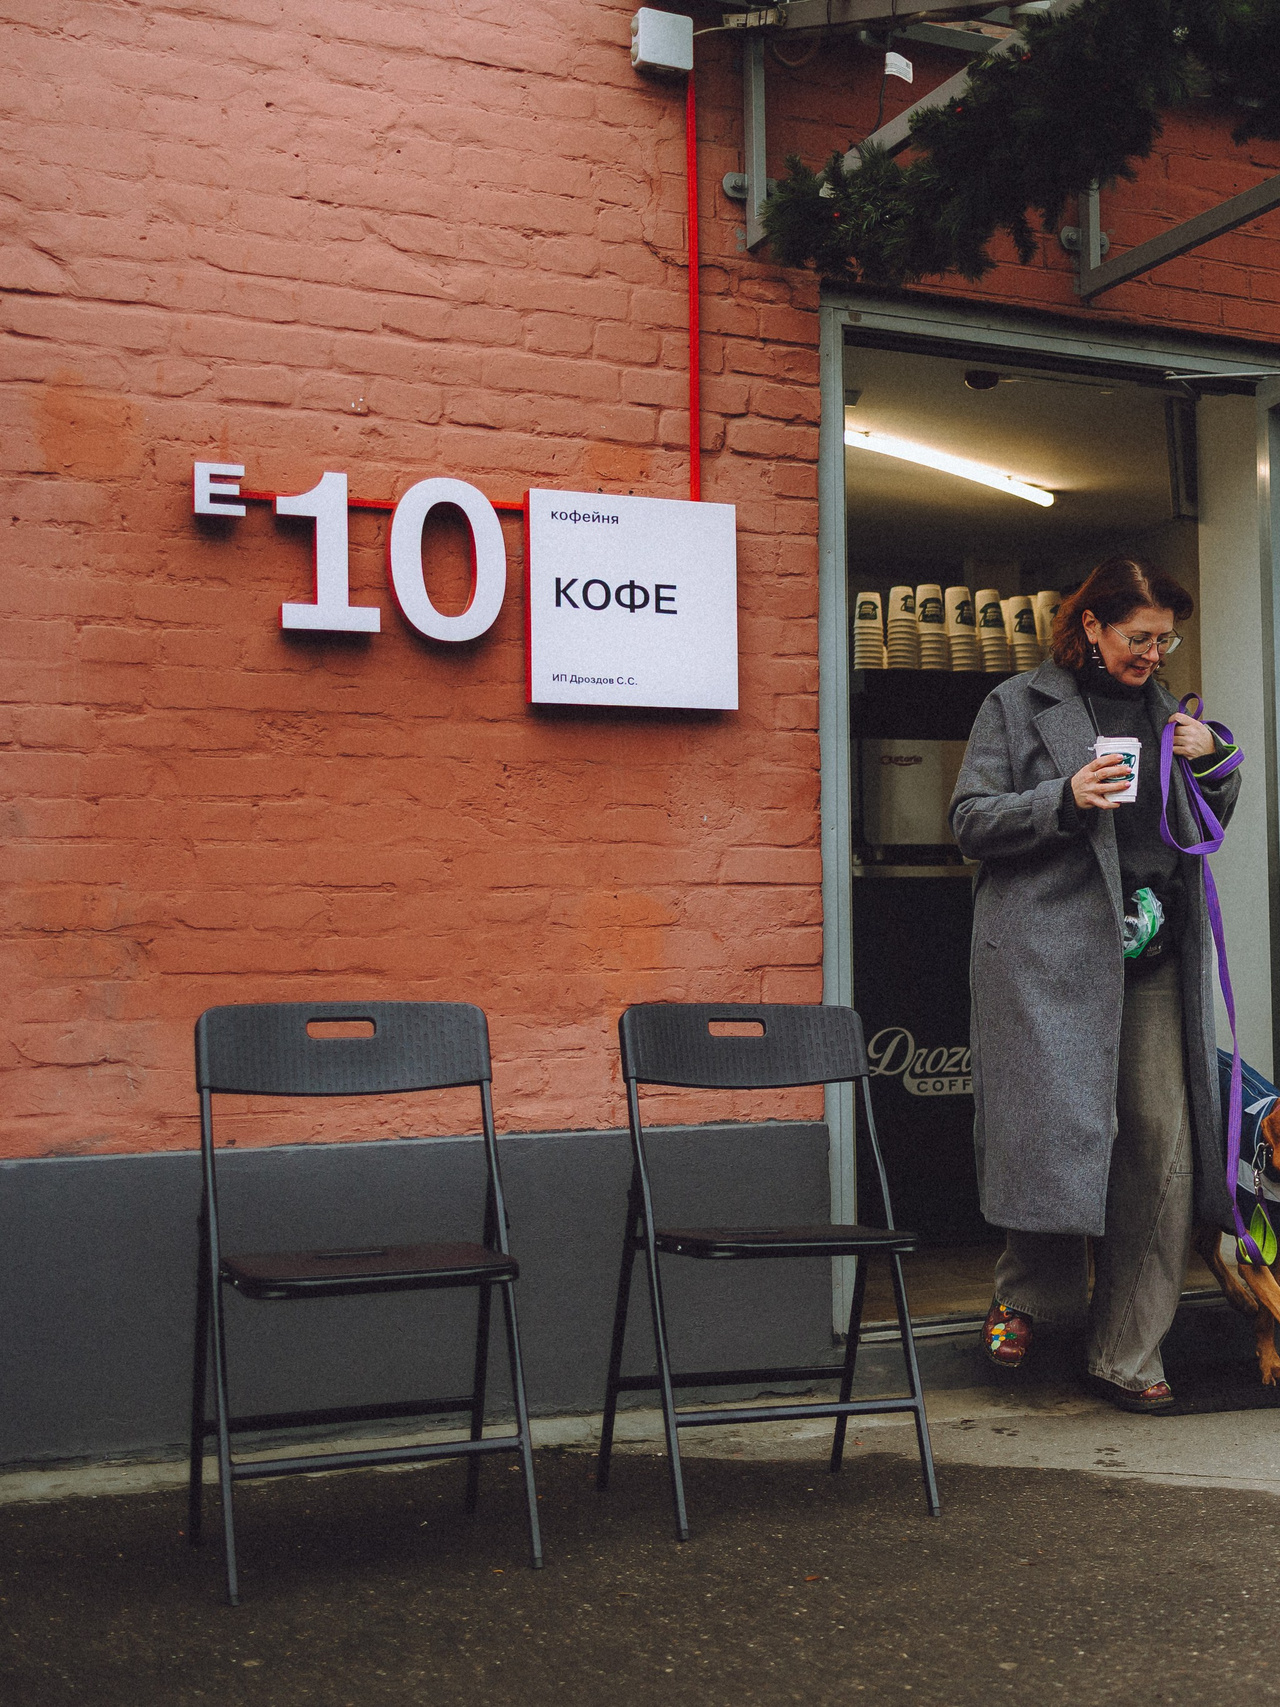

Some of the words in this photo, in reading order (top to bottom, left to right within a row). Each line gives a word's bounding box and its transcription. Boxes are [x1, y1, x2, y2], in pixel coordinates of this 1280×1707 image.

[550, 509, 620, 525] кофейня
[274, 471, 507, 643] 10
[554, 576, 678, 615] КОФЕ
[552, 673, 568, 683] ИП
[569, 674, 615, 685] Дроздов
[616, 676, 639, 686] С.С.
[916, 1078, 972, 1093] COFF
